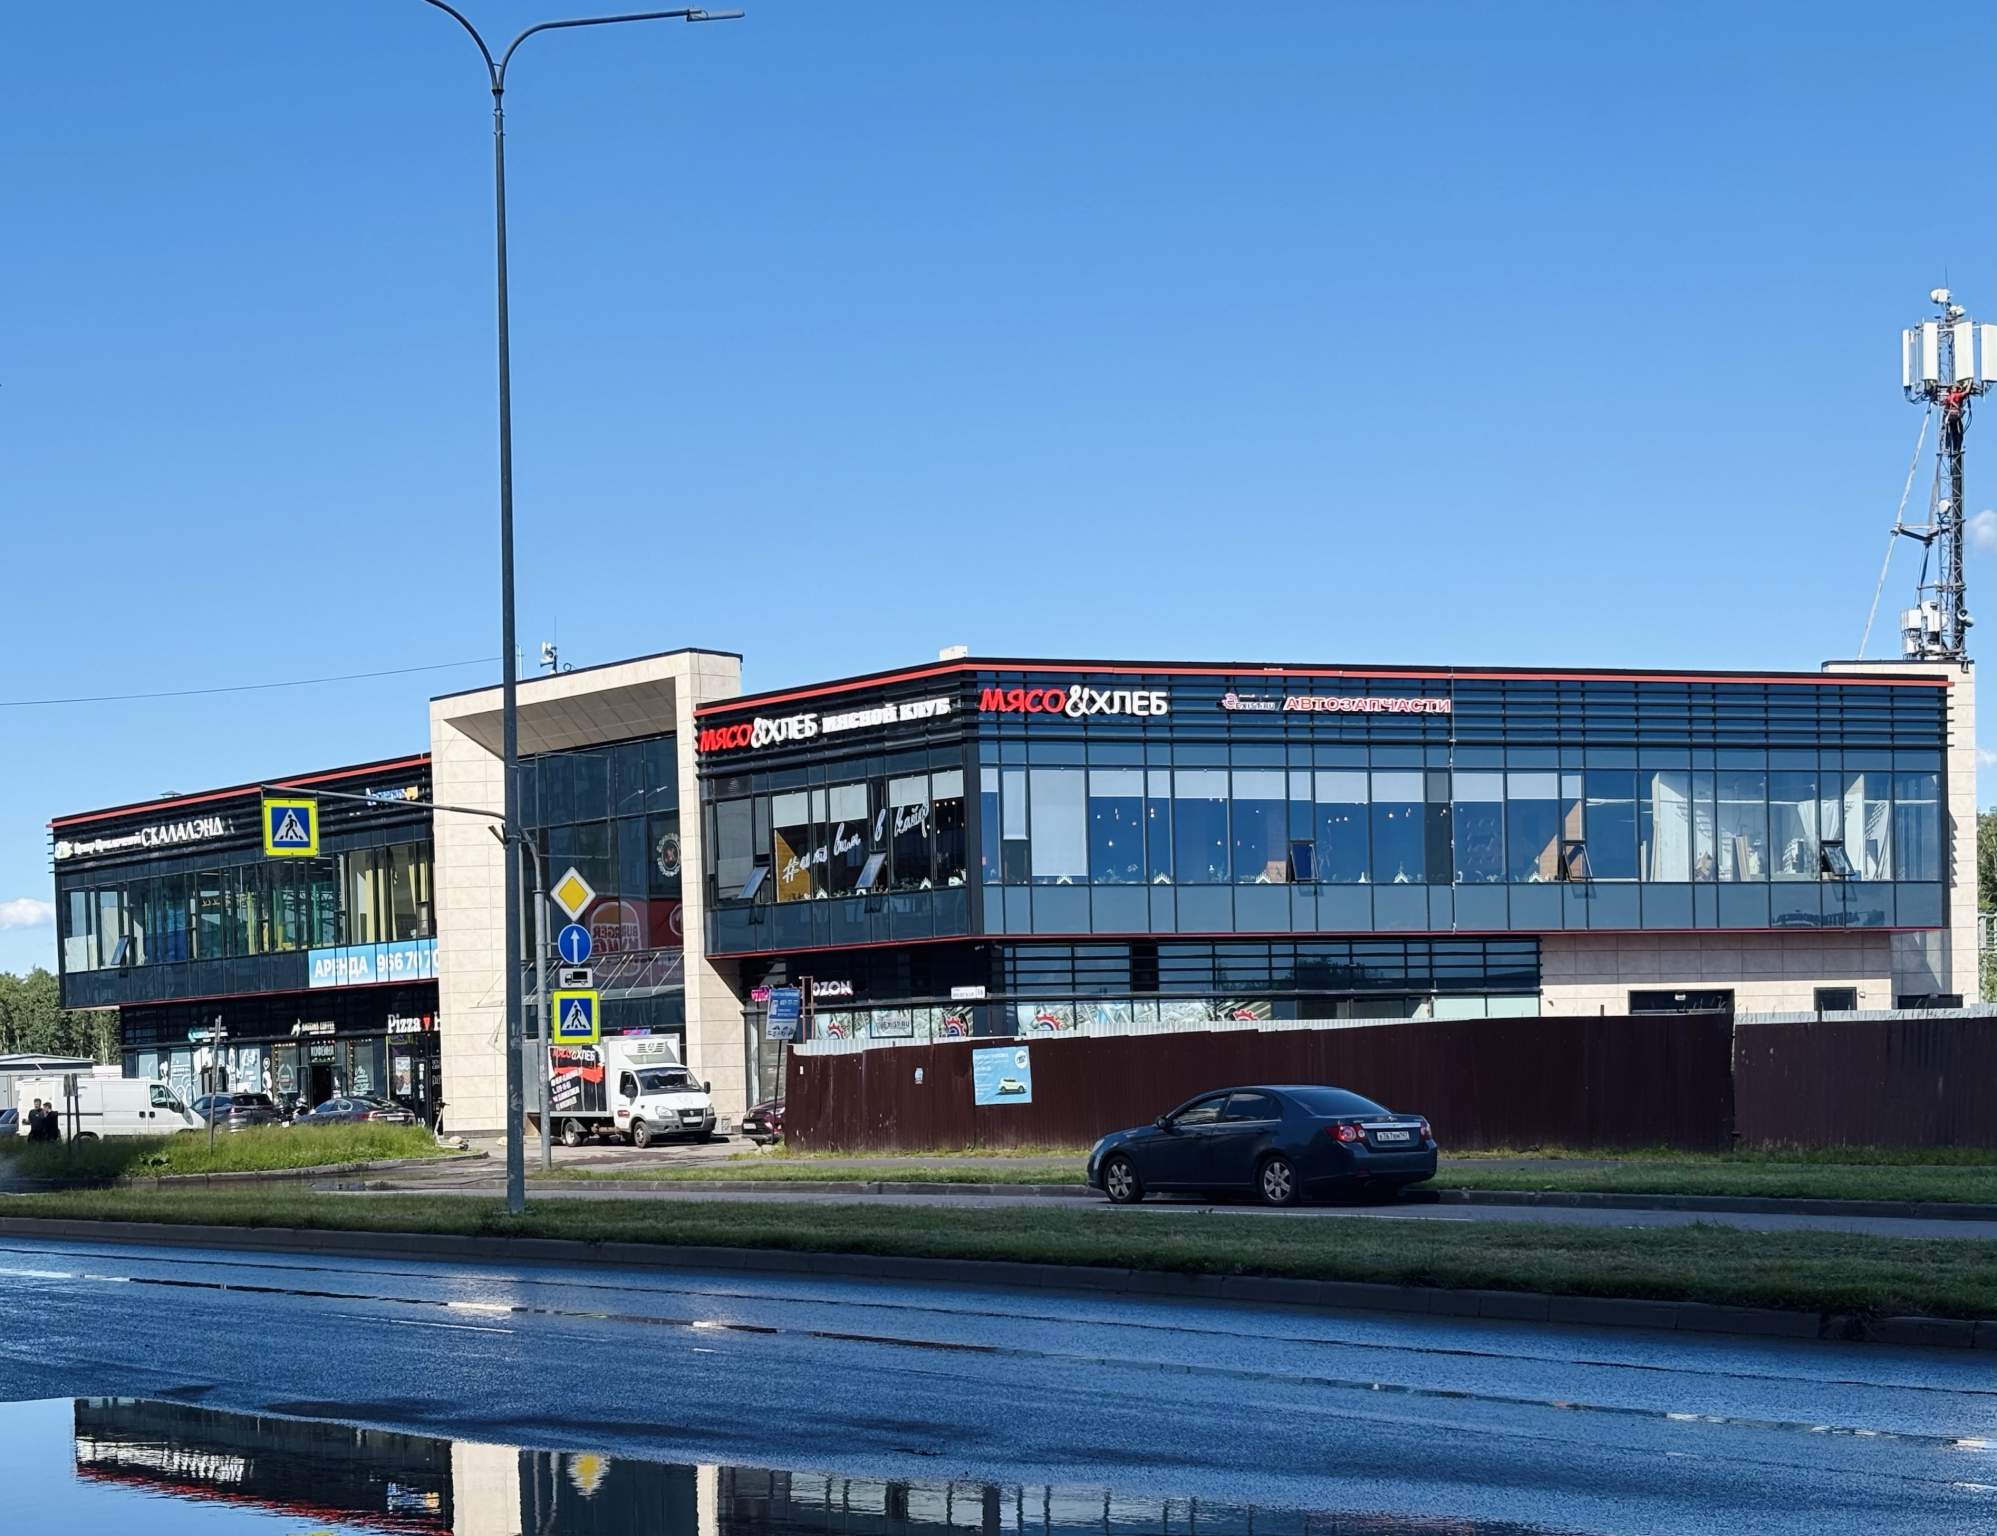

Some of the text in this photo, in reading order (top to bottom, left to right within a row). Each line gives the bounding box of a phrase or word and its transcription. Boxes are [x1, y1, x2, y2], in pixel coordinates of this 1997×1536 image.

[978, 684, 1169, 718] МЯСО&ХЛЕБ
[1283, 696, 1451, 713] АВТОЗАПЧАСТИ
[699, 712, 819, 752] МЯСО&ХЛЕБ
[141, 817, 224, 847] СКАЛАЛЭНД
[314, 955, 369, 978] АРЕНДА
[813, 980, 853, 997] OZON
[387, 1012, 422, 1034] Pizza
